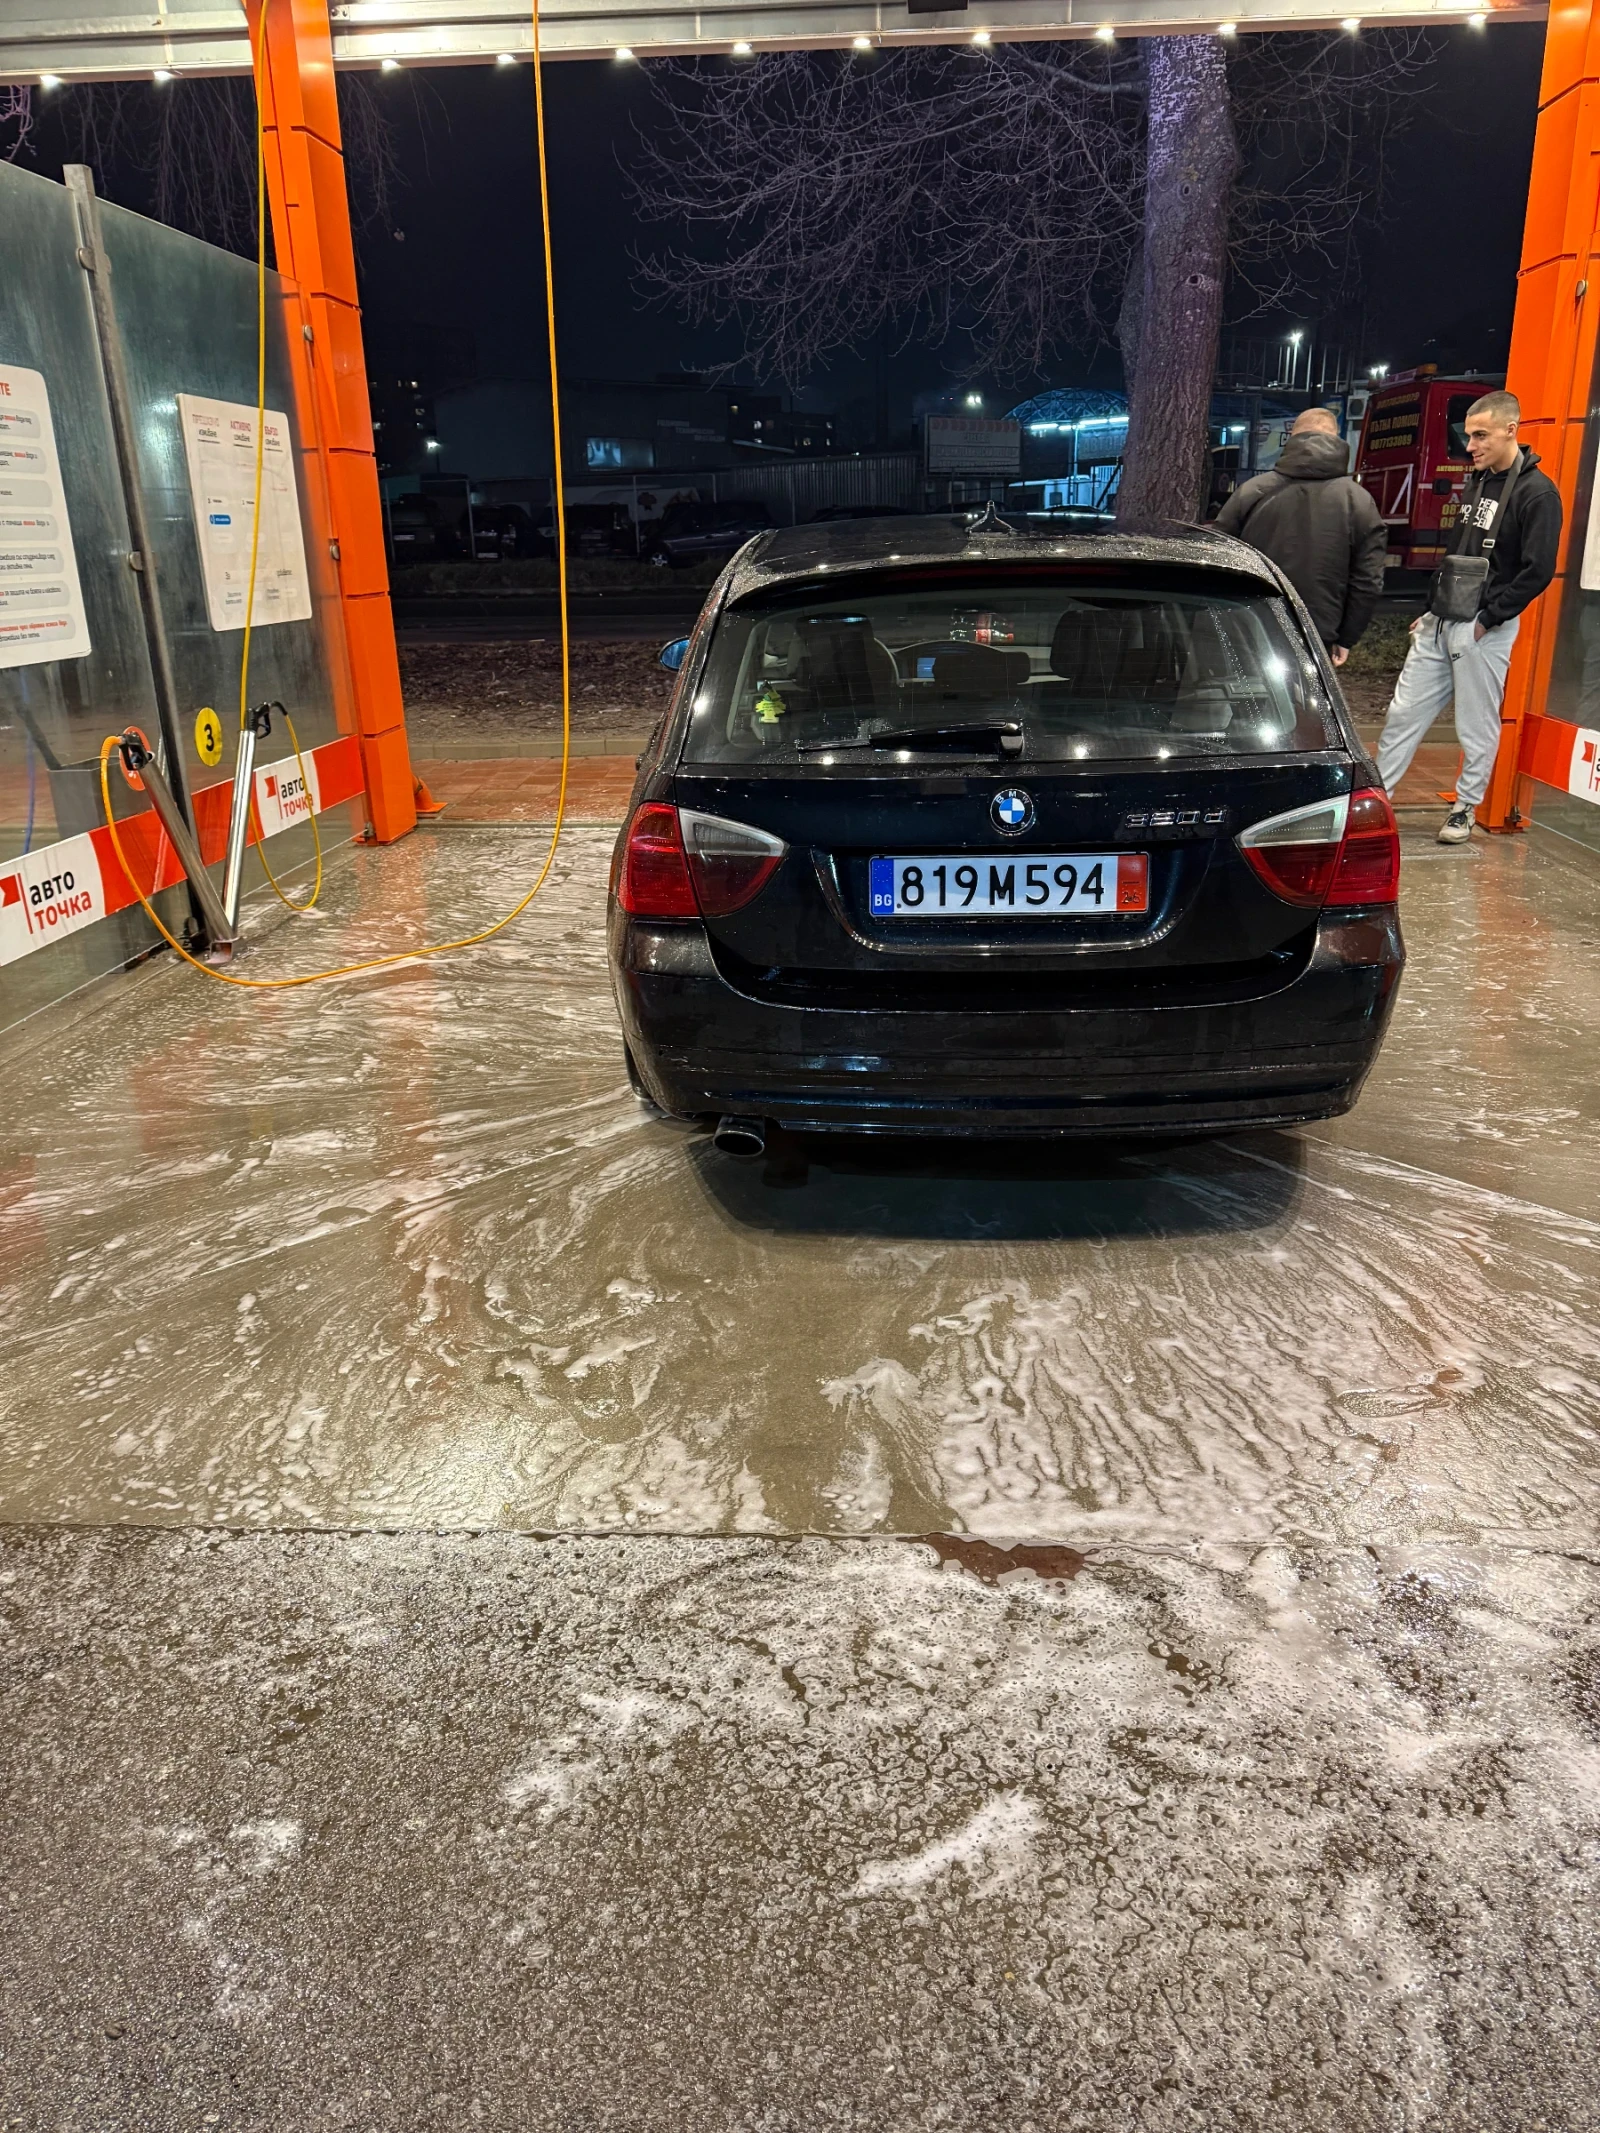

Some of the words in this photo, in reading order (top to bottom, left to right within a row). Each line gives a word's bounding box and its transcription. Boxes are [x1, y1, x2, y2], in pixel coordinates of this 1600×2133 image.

[1459, 504, 1489, 518] NOTH
[204, 724, 215, 752] 3
[281, 777, 305, 799] авто
[995, 790, 1031, 805] BMW
[29, 871, 75, 906] авто
[901, 863, 1104, 907] 819M594
[34, 891, 92, 931] точка
[874, 894, 892, 906] BG
